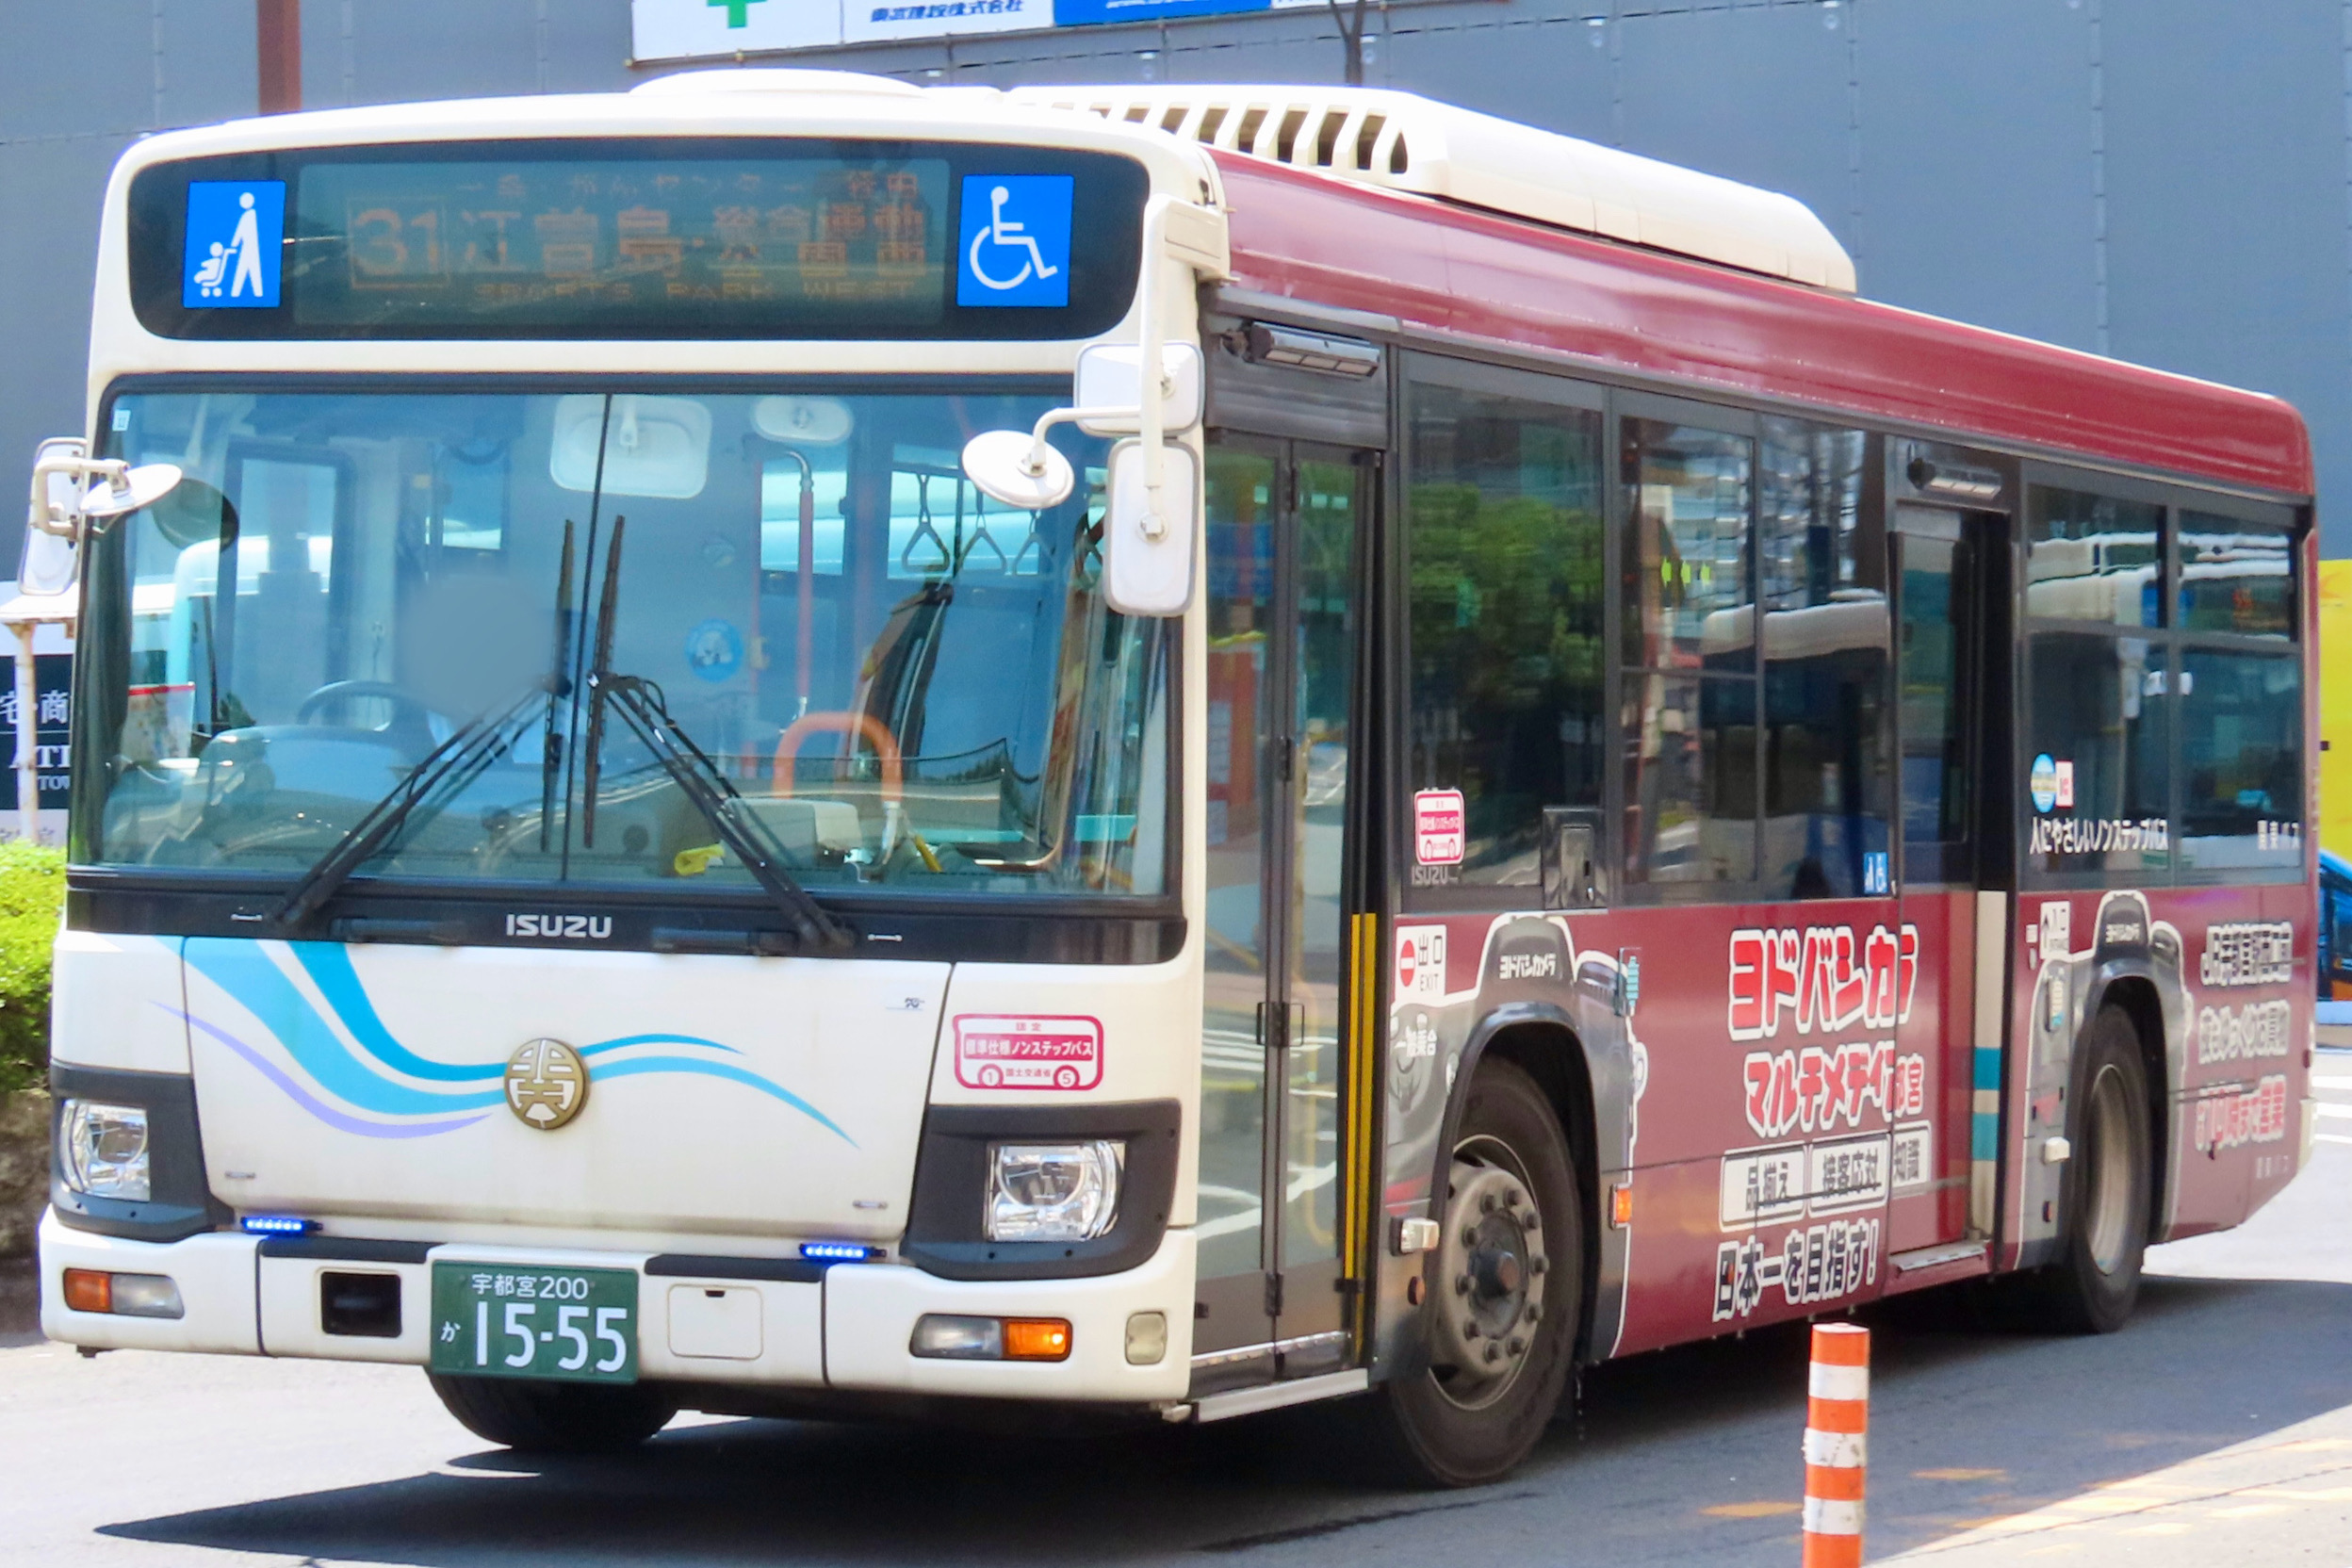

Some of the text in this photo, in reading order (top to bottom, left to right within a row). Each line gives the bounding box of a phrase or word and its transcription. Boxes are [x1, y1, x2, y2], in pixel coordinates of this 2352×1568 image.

[354, 208, 437, 275] 31
[2030, 816, 2168, 855] 人にやさしいノンステップバス
[506, 914, 612, 939] ISUZU
[1418, 934, 1443, 966] 出口
[1420, 973, 1439, 992] EXIT
[965, 1039, 1093, 1057] 標準仕様ノンステップバス
[471, 1273, 589, 1300] 宇都宮200
[440, 1320, 462, 1344] か
[475, 1300, 629, 1373] 15-55
